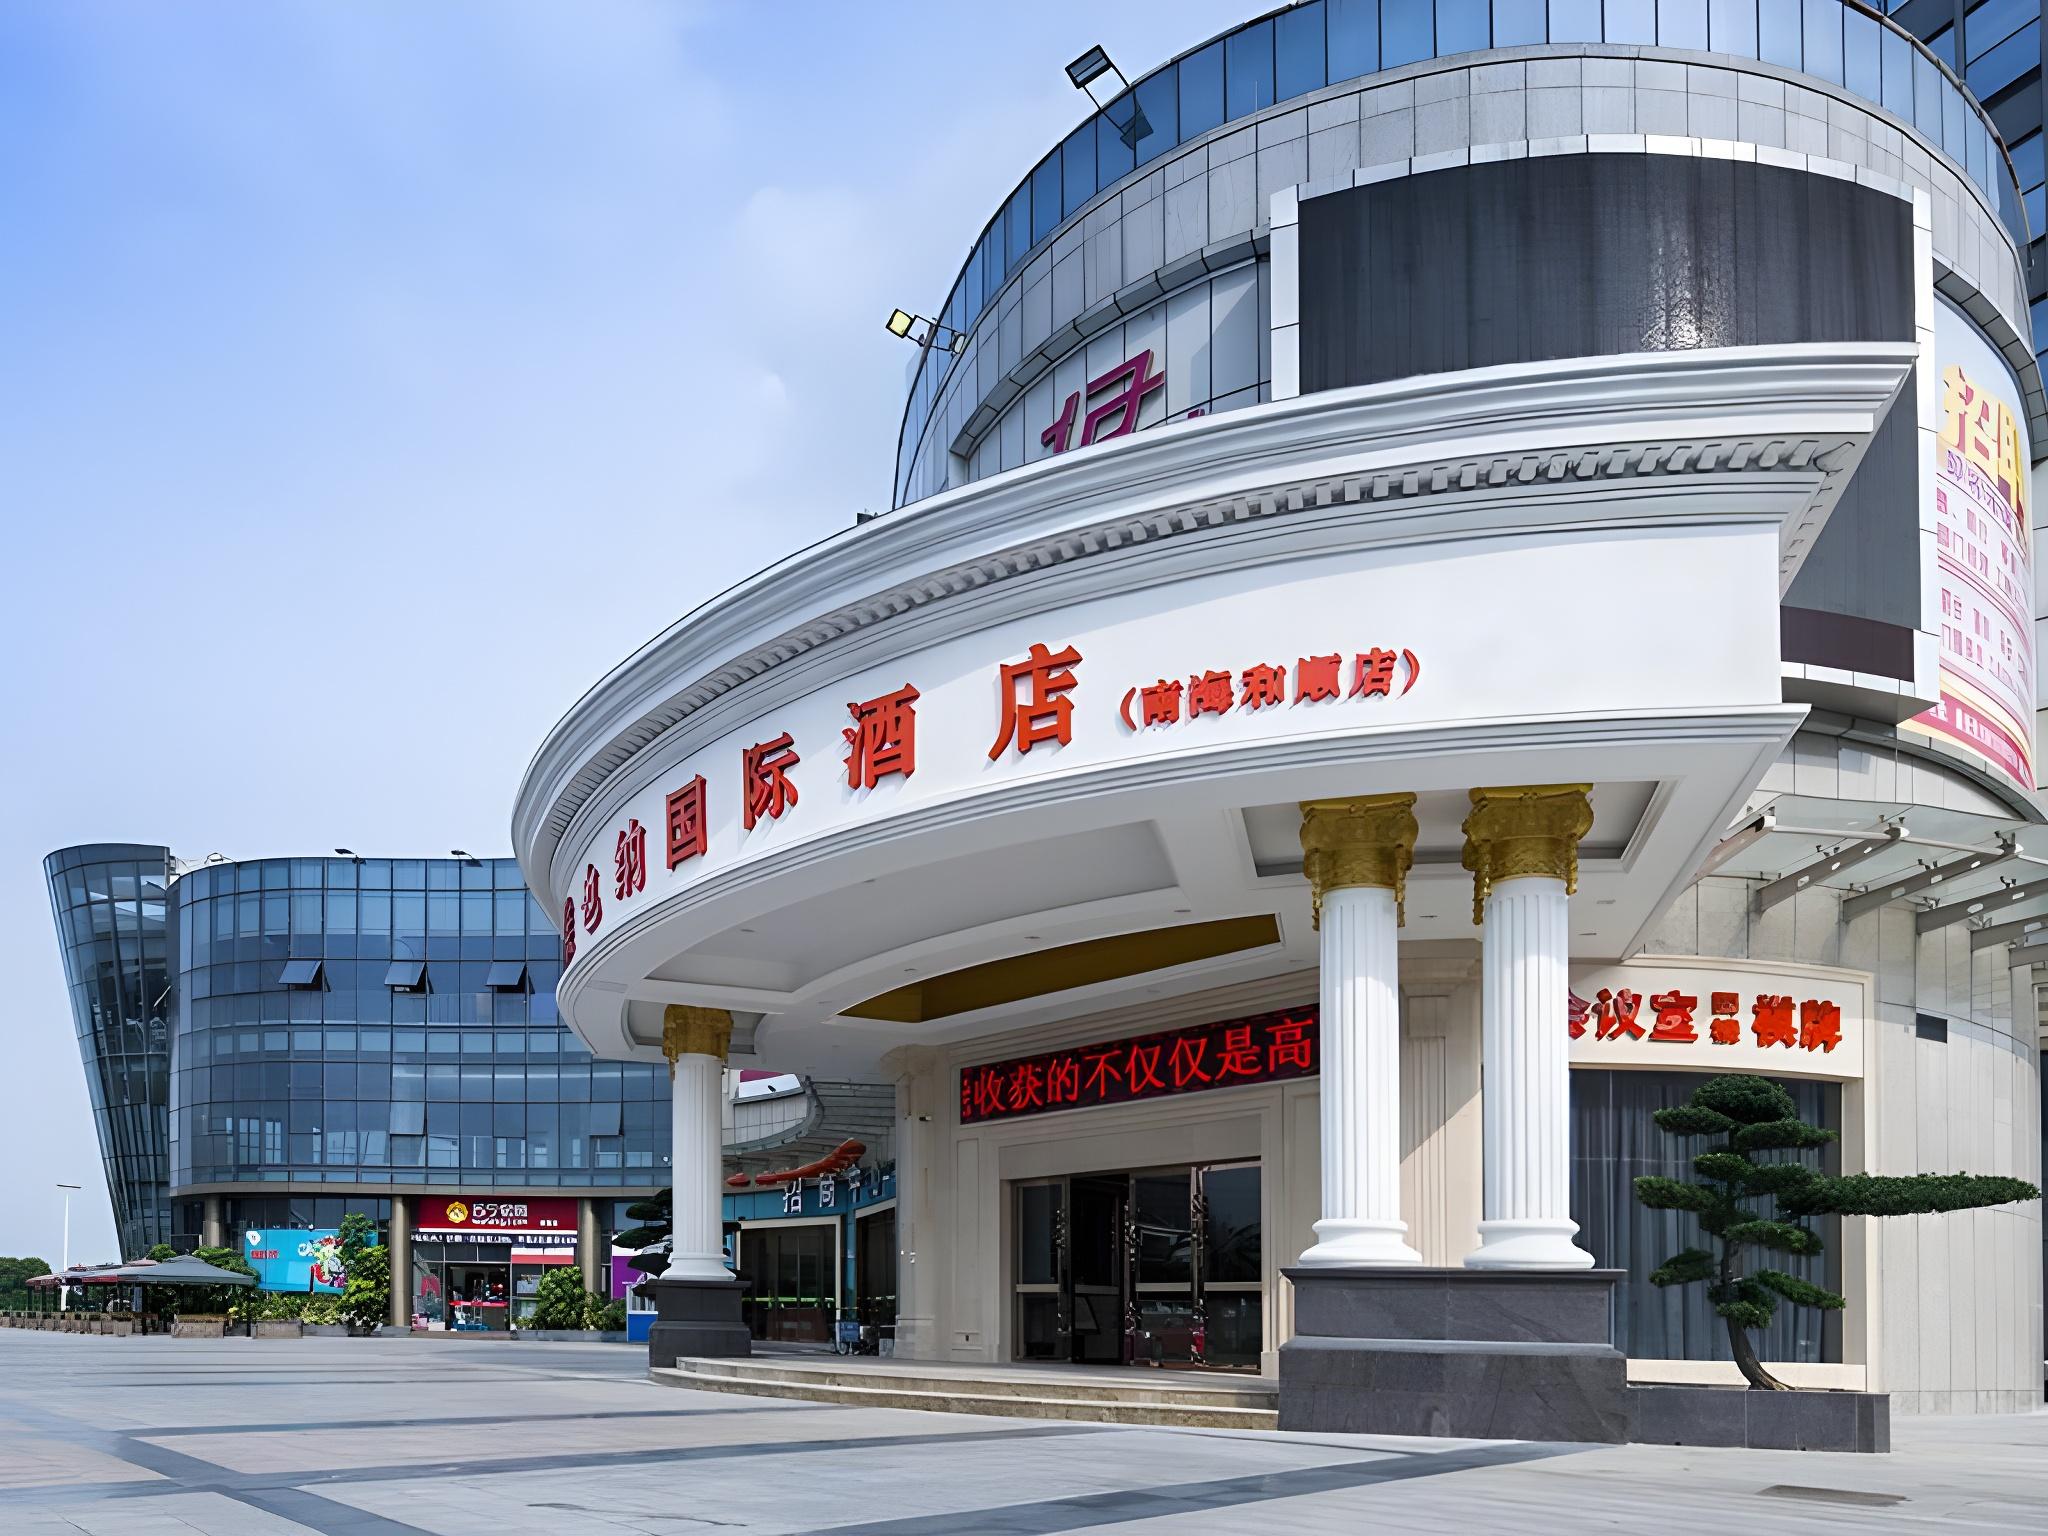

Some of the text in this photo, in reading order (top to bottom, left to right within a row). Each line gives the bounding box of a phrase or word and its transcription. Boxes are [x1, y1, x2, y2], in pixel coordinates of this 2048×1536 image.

[962, 1018, 1315, 1118] 收获的不仅仅是高
